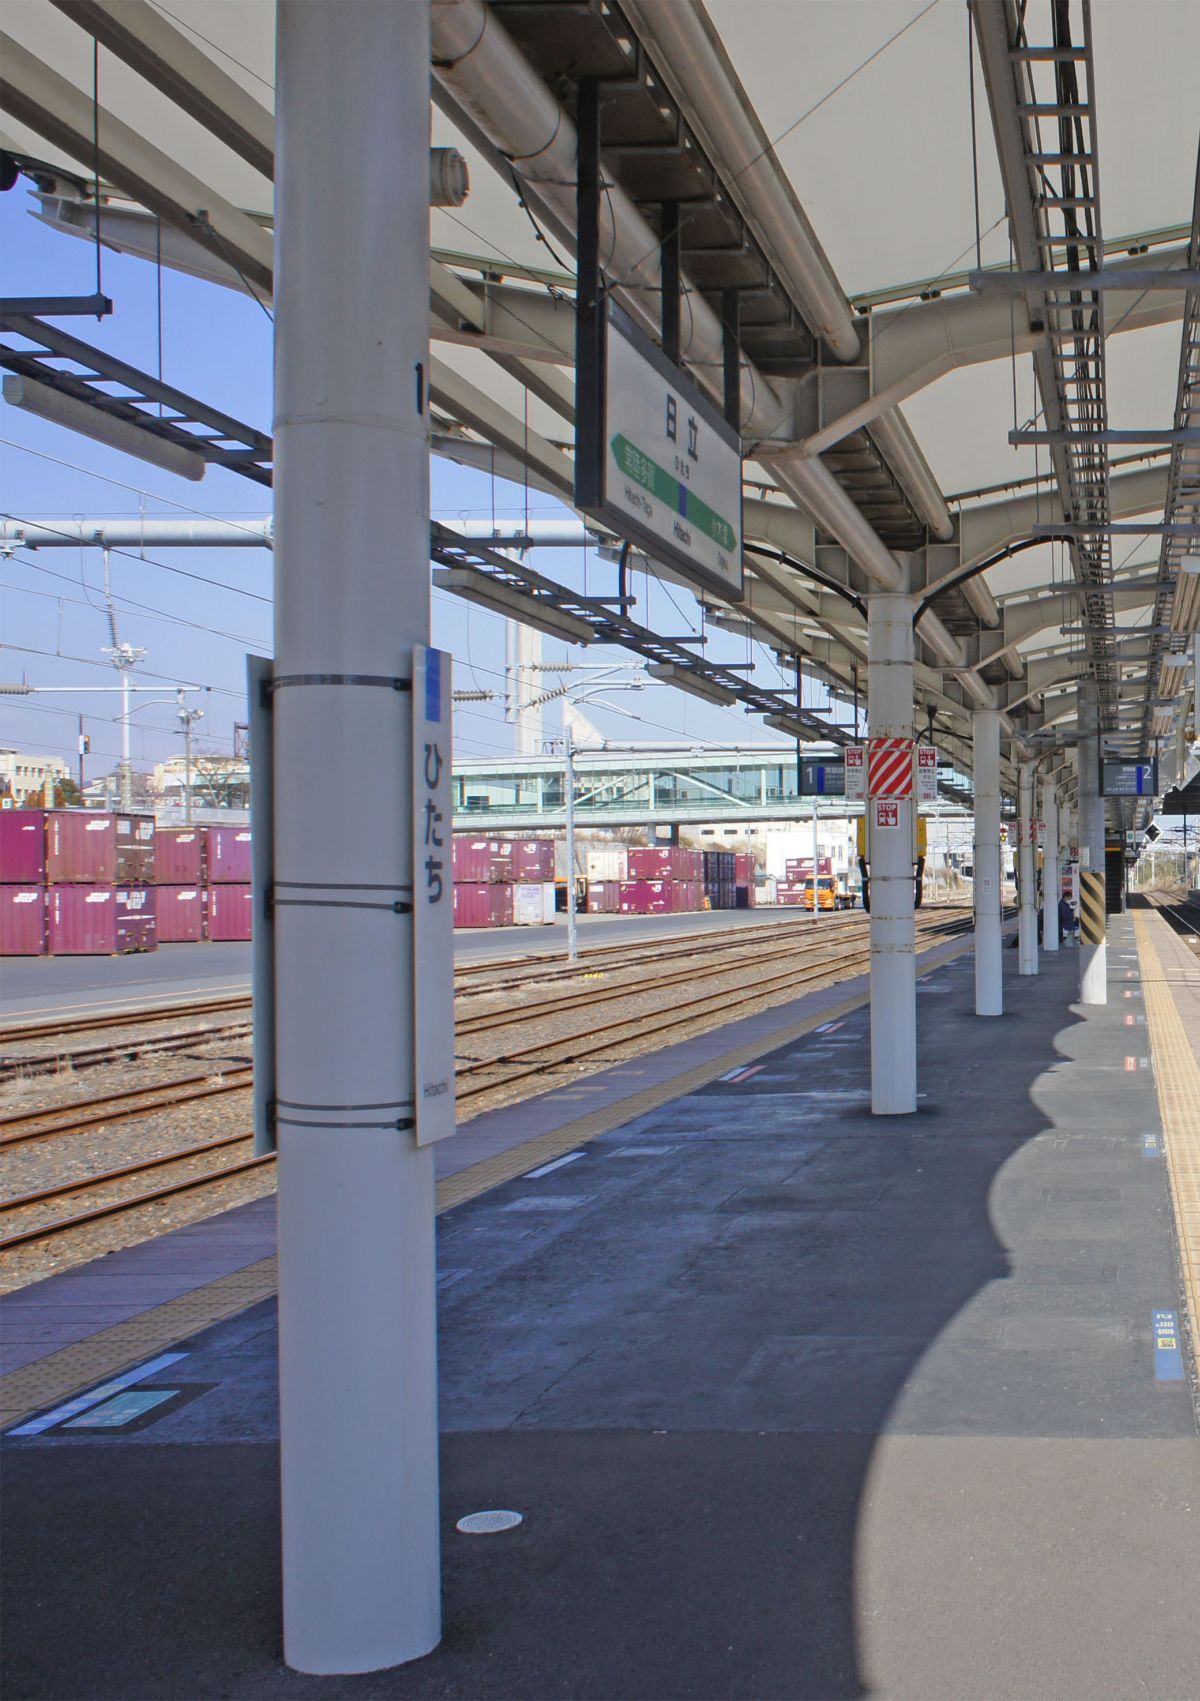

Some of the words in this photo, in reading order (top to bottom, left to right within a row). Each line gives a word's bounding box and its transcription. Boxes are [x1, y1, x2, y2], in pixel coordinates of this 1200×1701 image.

[667, 393, 698, 462] 日立
[675, 455, 690, 480] ひたち
[806, 766, 813, 785] 1
[1143, 766, 1152, 779] 2
[424, 742, 443, 904] ひたち
[523, 843, 537, 852] JR
[423, 1078, 449, 1100] Hitachi
